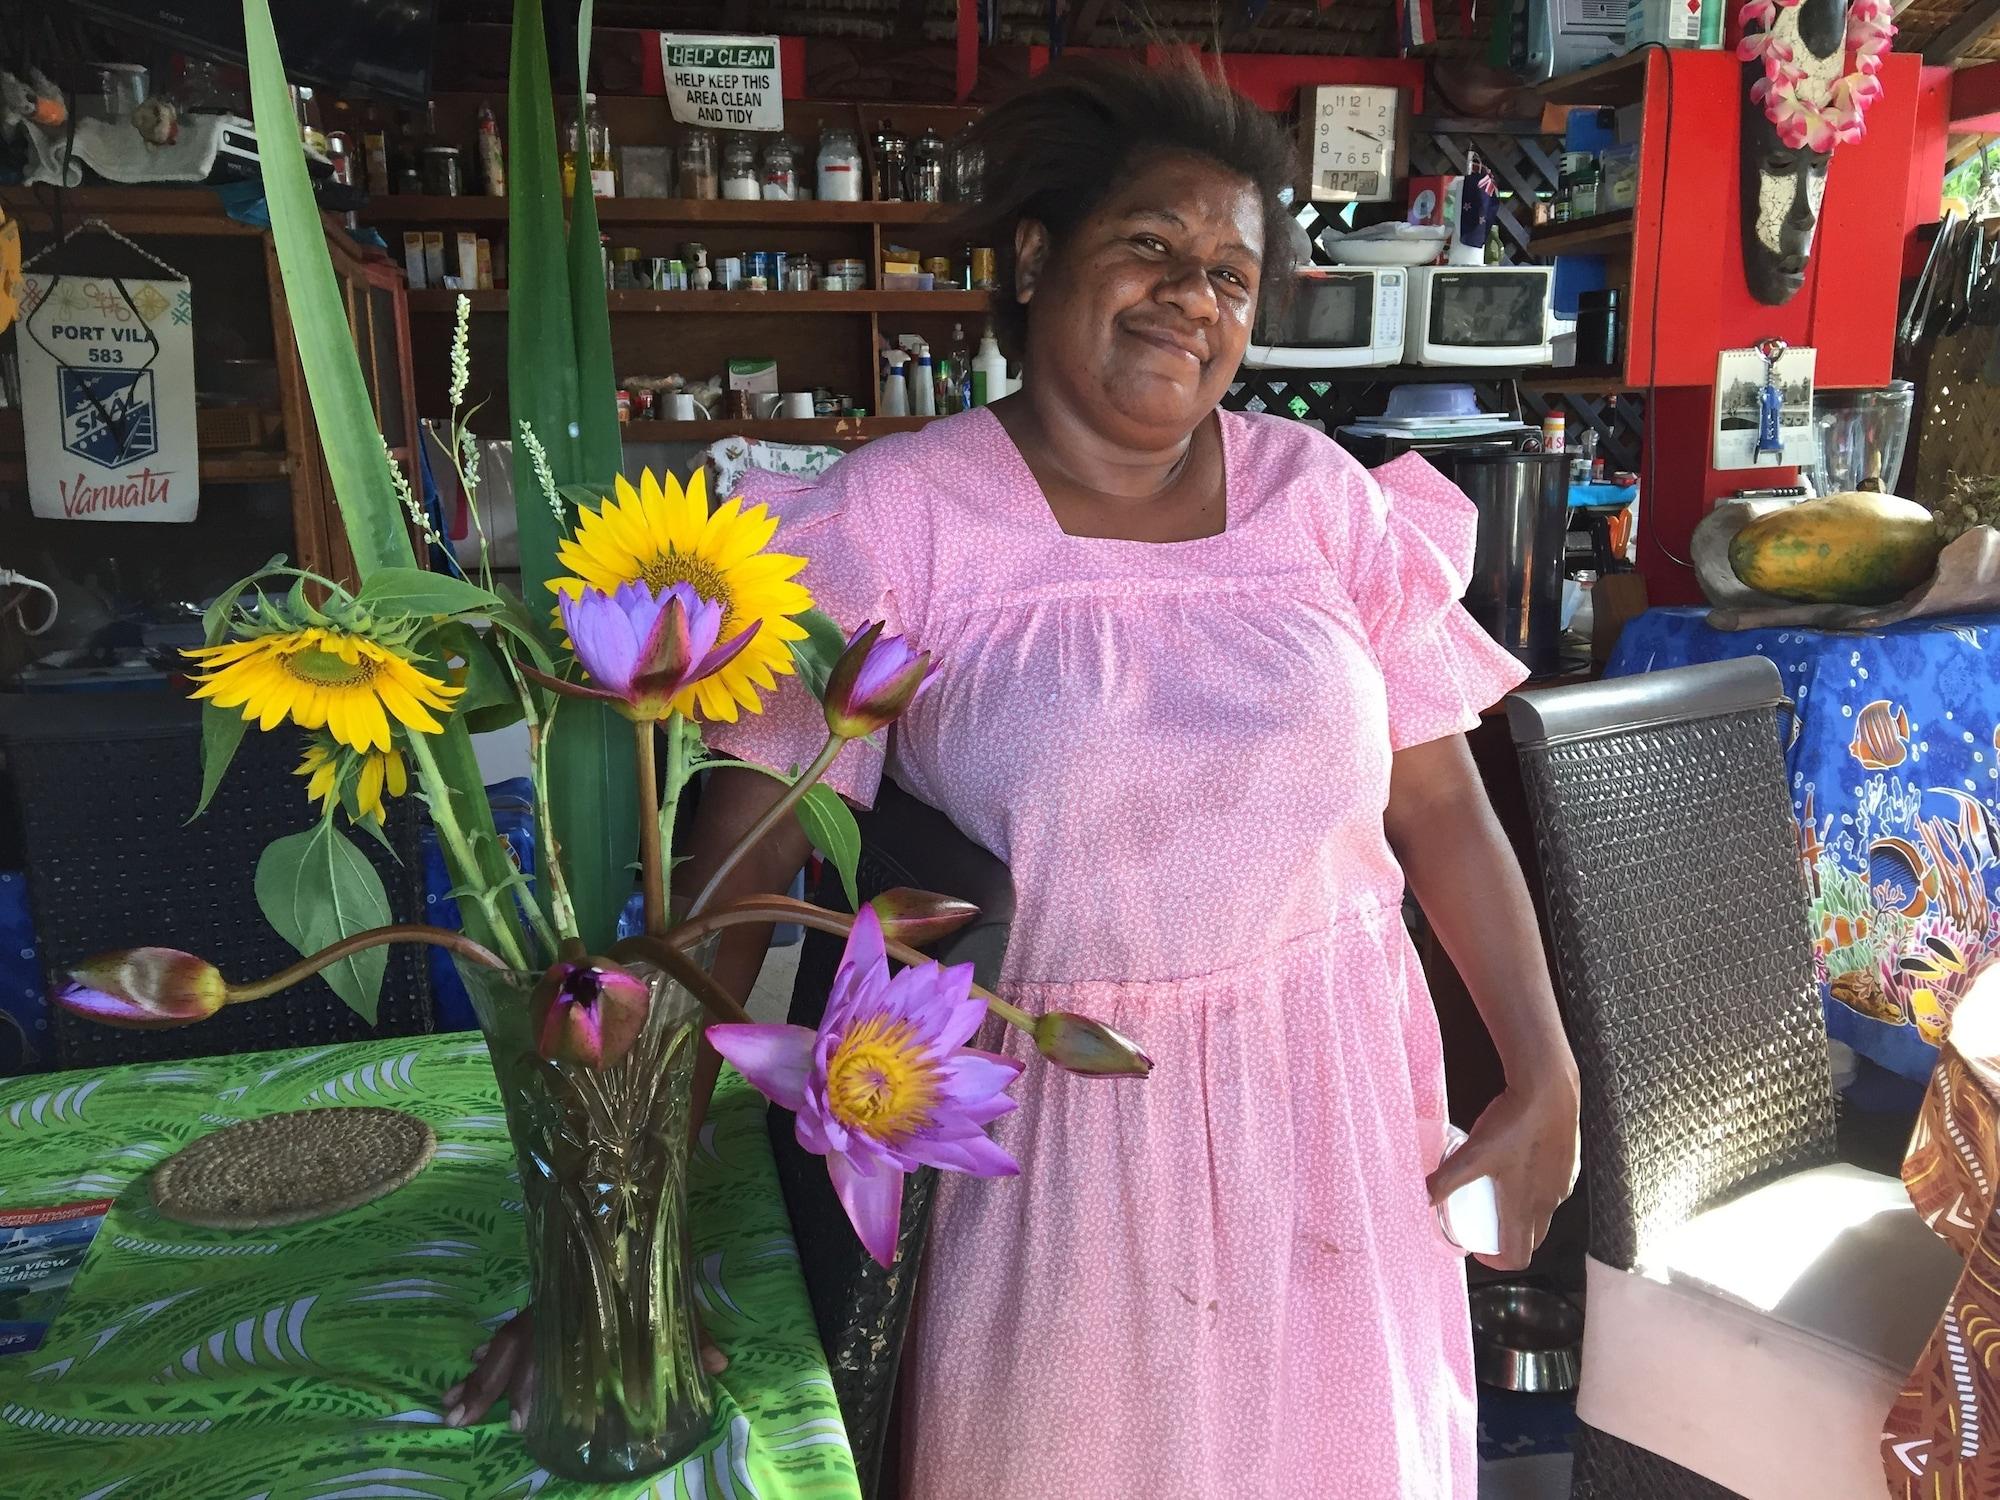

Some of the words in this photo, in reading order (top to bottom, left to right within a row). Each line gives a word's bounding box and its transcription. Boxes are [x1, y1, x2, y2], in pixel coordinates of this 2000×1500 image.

[672, 48, 714, 65] HELP
[718, 48, 770, 66] CLEAN
[675, 73, 705, 87] HELP
[709, 74, 739, 89] KEEP
[742, 75, 770, 89] THIS
[687, 90, 719, 105] AREA
[721, 91, 762, 107] CLEAN
[1336, 95, 1345, 107] 11
[1350, 95, 1361, 108] 12
[698, 107, 723, 122] AND
[726, 109, 753, 124] TIDY
[1322, 104, 1334, 117] 10
[1377, 105, 1386, 118] 2
[1320, 123, 1330, 136] 9
[1377, 124, 1386, 137] 3
[1320, 141, 1330, 154] 8
[1375, 142, 1384, 155] 4
[1334, 152, 1342, 164] 7
[1347, 152, 1357, 165] 6
[1361, 152, 1371, 165] 5
[52, 325, 105, 341] PORT
[88, 347, 124, 364] 583
[59, 467, 178, 519] Vanuatu
[25, 1259, 71, 1272] view
